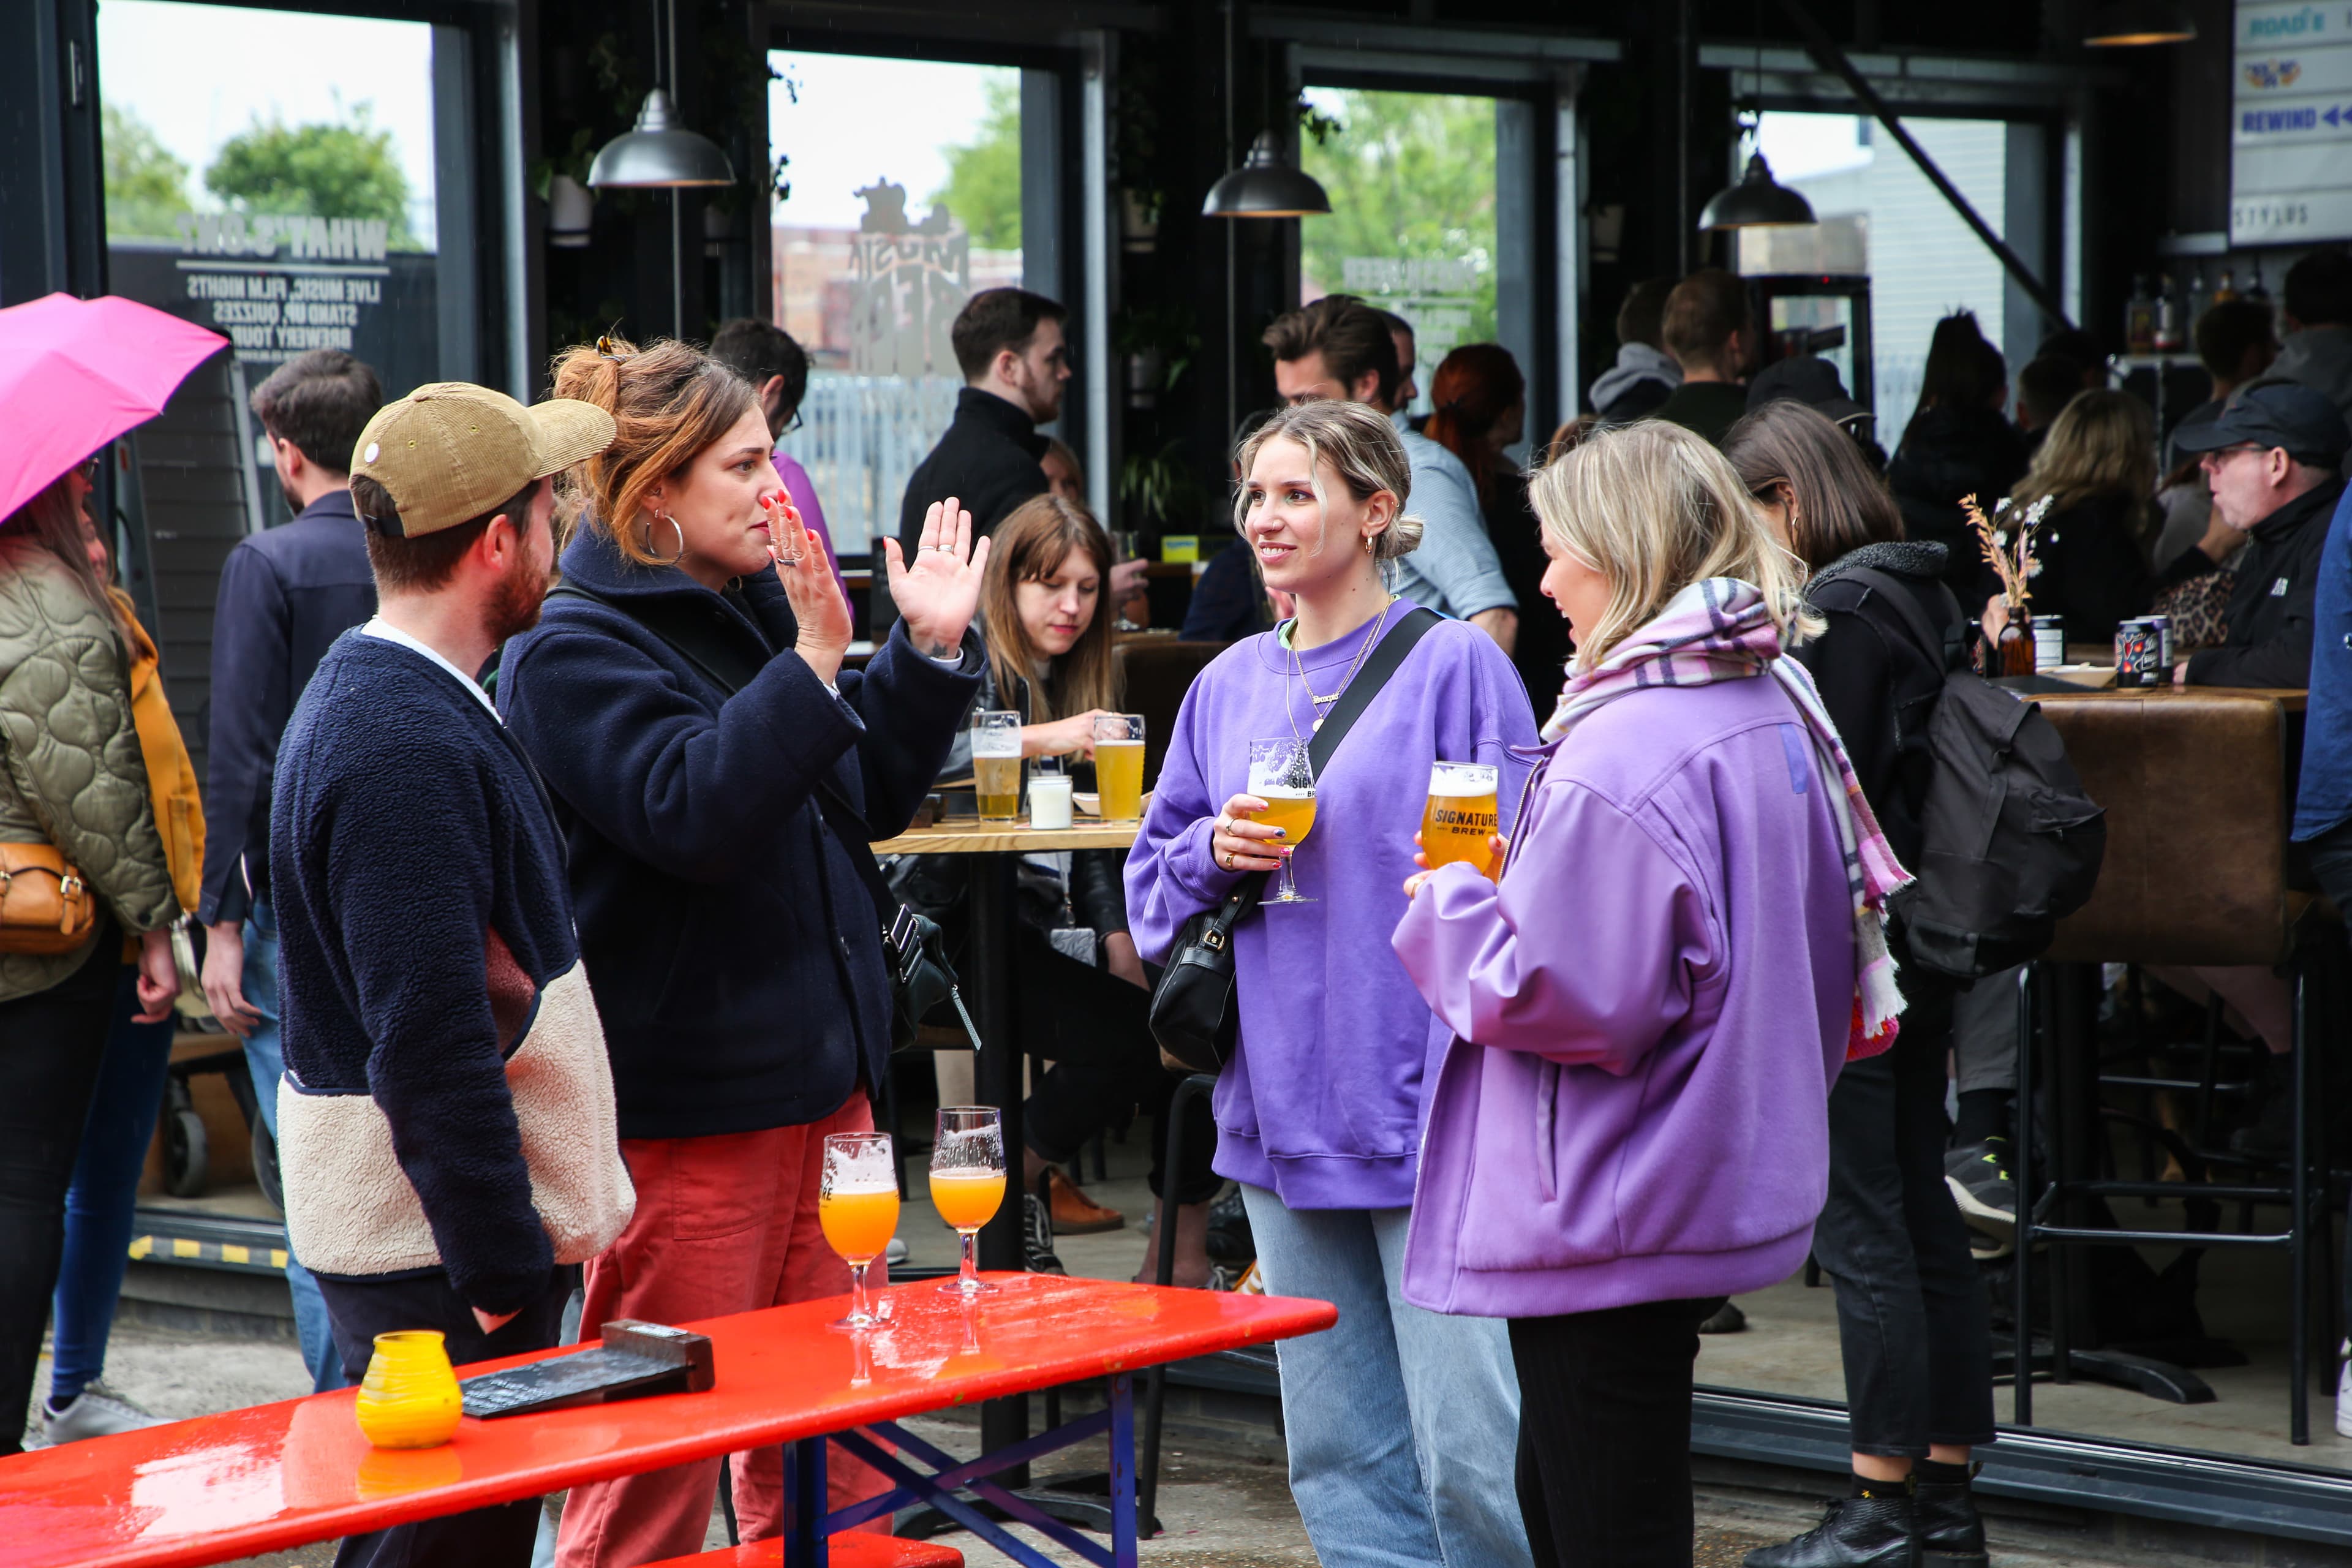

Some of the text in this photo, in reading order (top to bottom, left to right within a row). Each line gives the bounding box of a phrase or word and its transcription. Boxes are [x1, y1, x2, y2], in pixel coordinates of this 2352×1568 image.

[2242, 107, 2316, 133] REWIND
[1435, 809, 1497, 827] SIGNATURE
[1452, 827, 1486, 835] BREW
